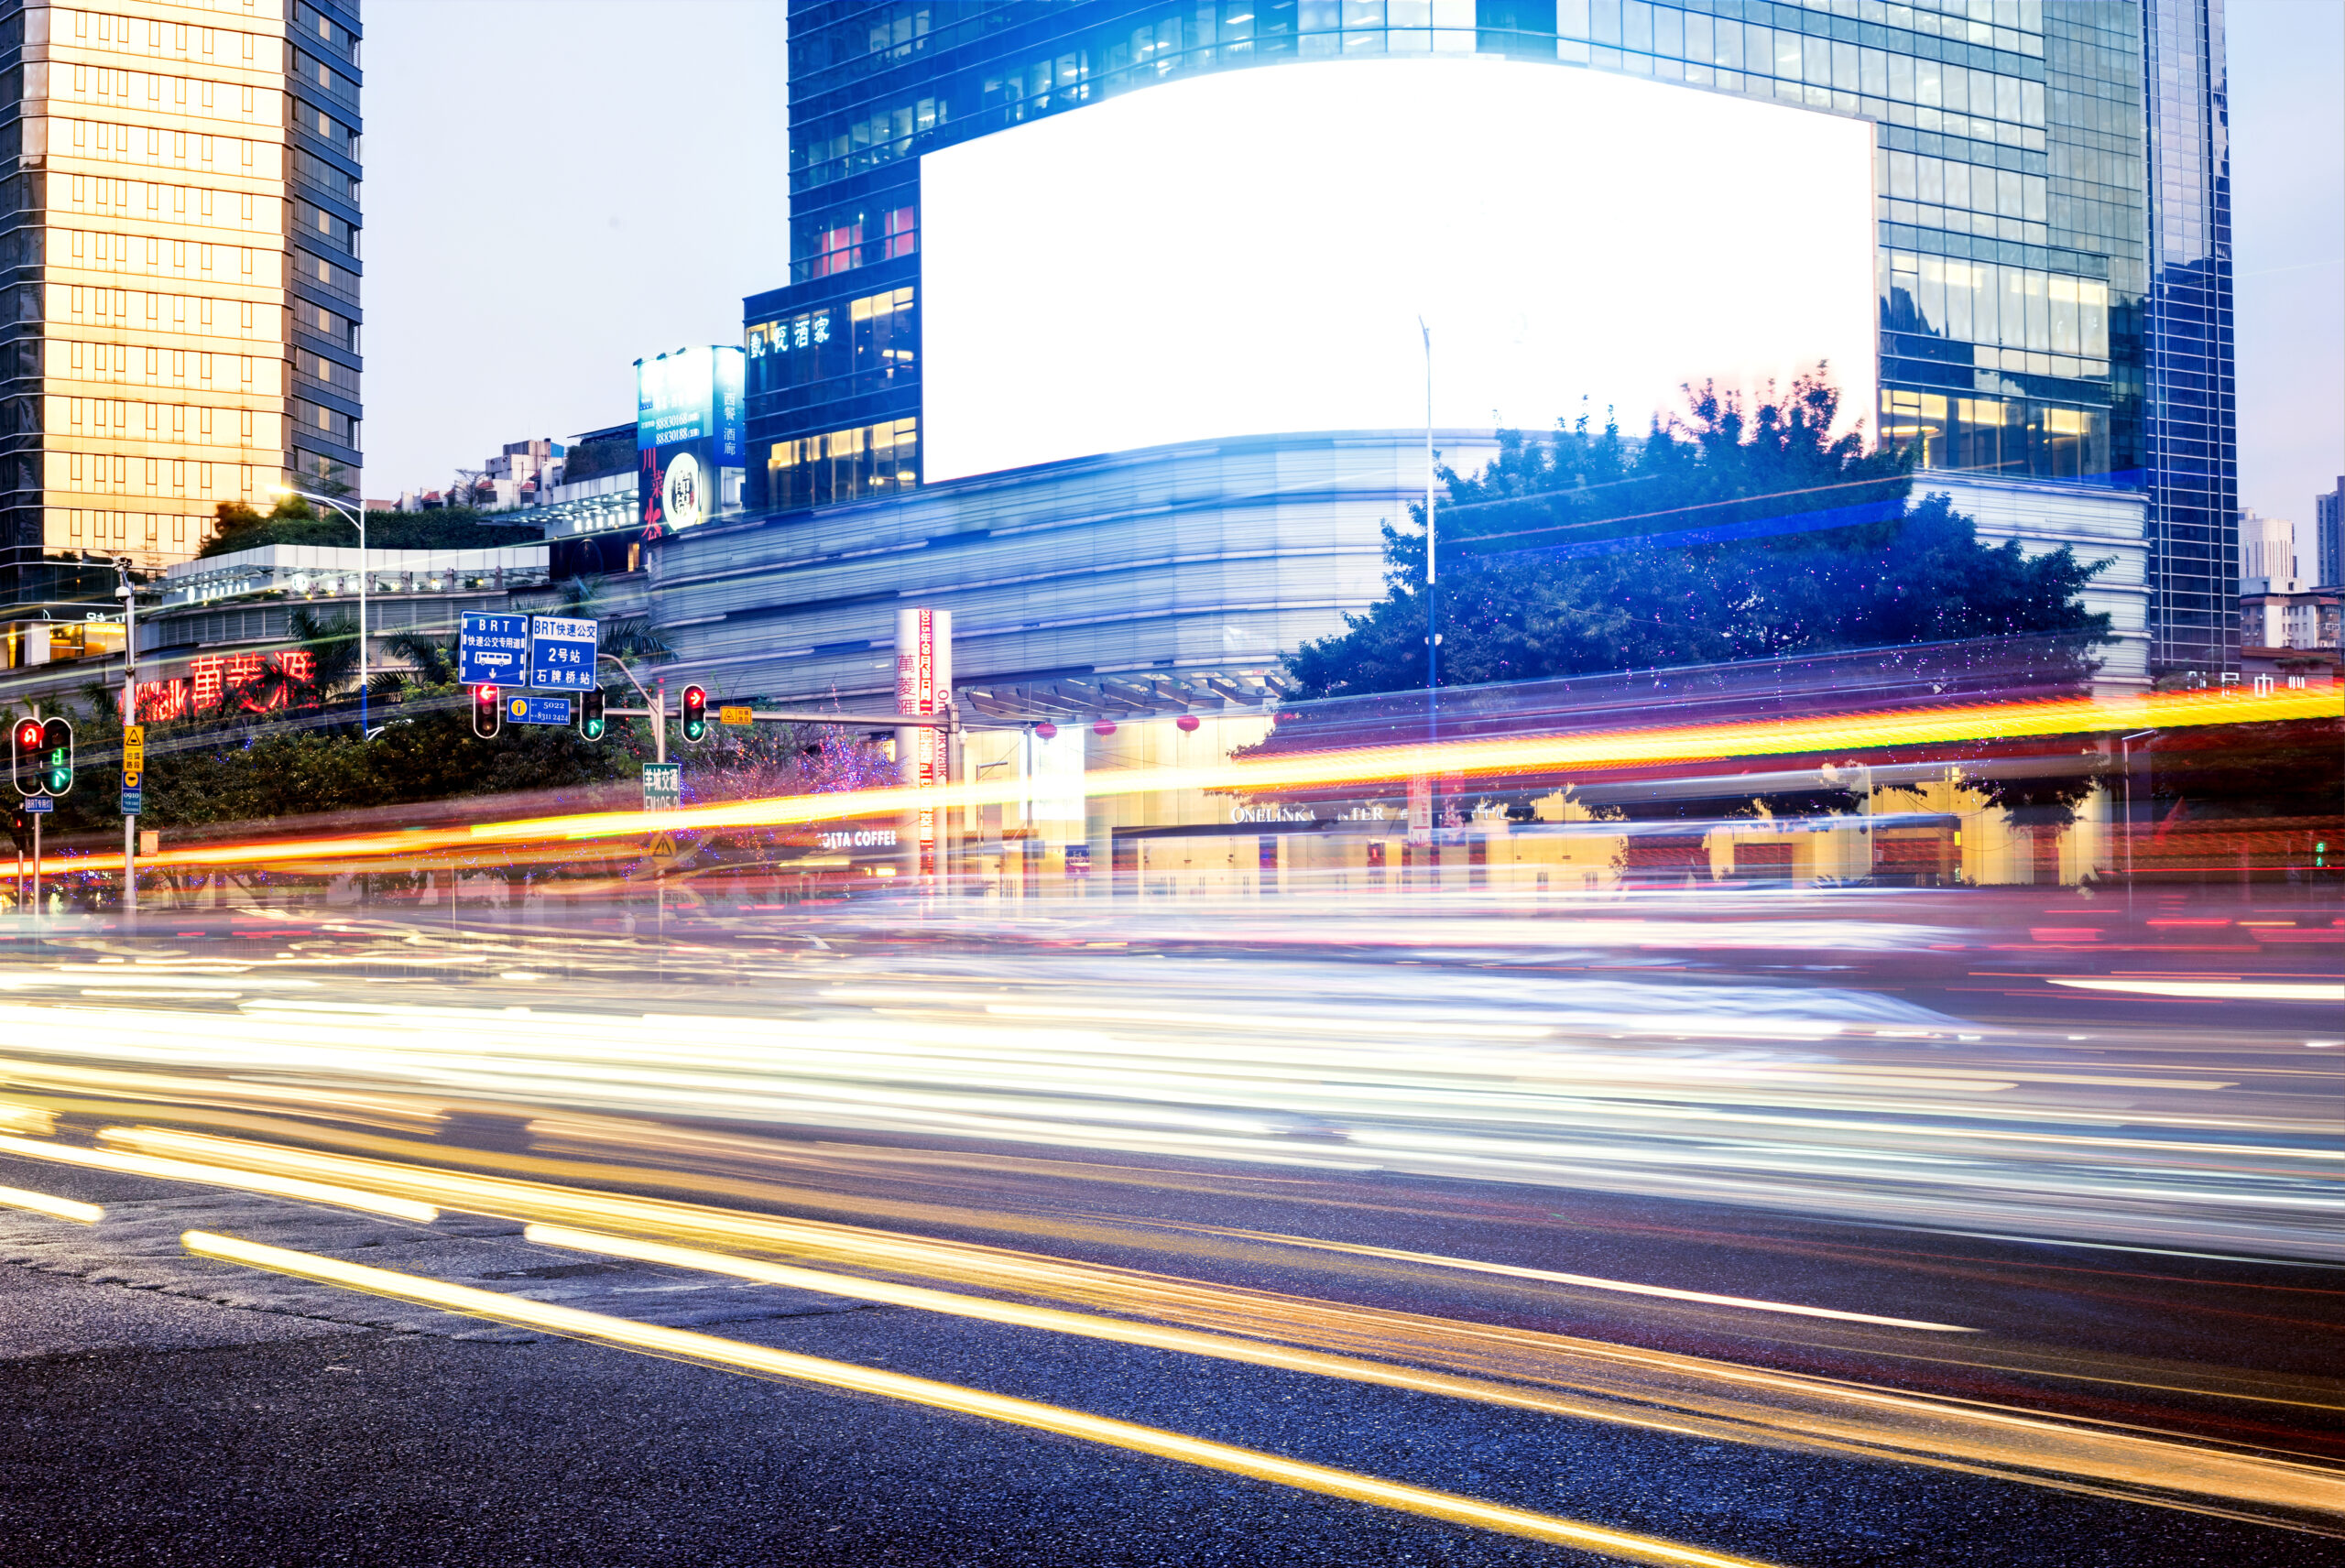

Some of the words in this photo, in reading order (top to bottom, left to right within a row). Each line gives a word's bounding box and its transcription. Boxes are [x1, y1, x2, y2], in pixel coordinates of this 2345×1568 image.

[656, 428, 688, 445] 88830188
[478, 619, 510, 633] BRT
[534, 620, 596, 638] BRT快速公交
[467, 635, 521, 649] 快速公交专用道
[548, 648, 581, 664] 2号站
[537, 669, 591, 685] 石牌桥站
[543, 702, 565, 710] 5022
[644, 768, 679, 792] 羊城交通
[645, 795, 679, 813] FM1052
[1230, 806, 1308, 822] ONELINK
[814, 831, 852, 849] OSTA
[855, 830, 897, 847] COFFEE
